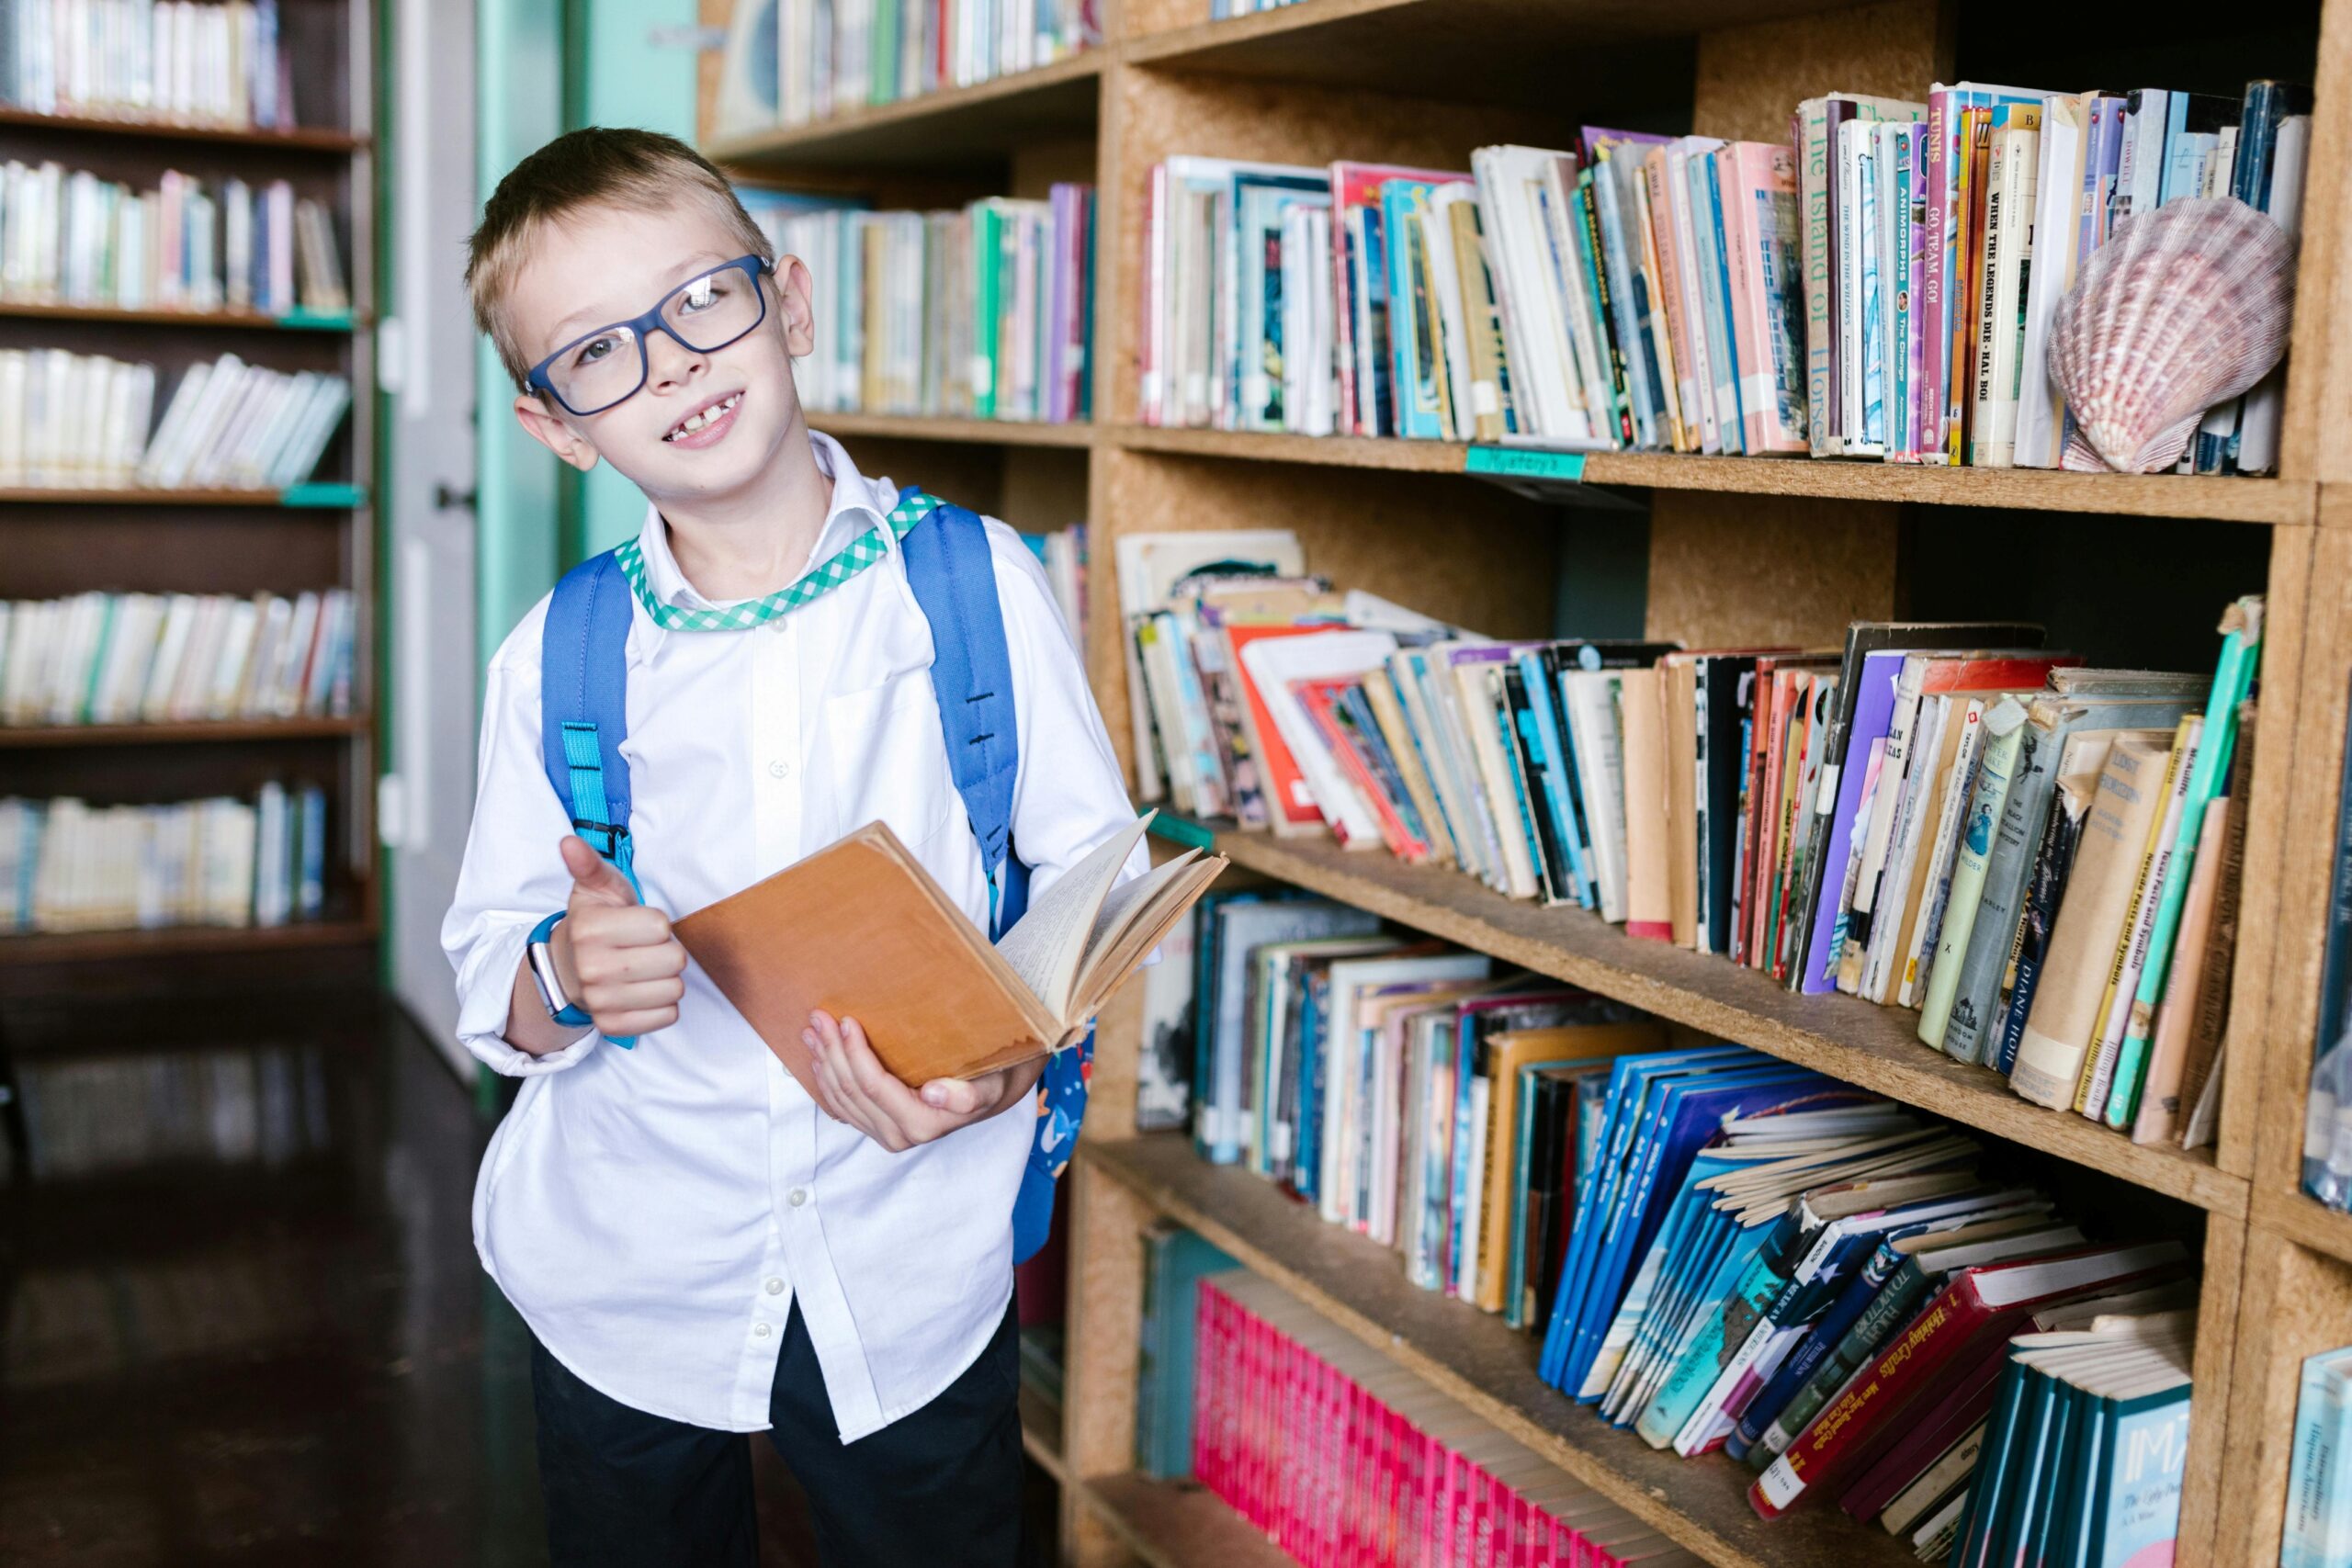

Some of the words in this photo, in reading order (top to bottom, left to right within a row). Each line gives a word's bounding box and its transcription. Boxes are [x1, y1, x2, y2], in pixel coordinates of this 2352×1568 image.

[1807, 117, 1828, 177] The
[1929, 107, 1942, 164] TUNIS
[2122, 141, 2133, 184] DOWELL
[1988, 192, 2000, 231] WHEN
[1810, 190, 1829, 282] Island
[1897, 186, 1908, 281] ANIMORPHS
[1988, 233, 1998, 259] THE
[1844, 251, 1850, 261] IN
[1926, 280, 1939, 303] GO!
[1984, 263, 1997, 317] LEGENDS
[1812, 293, 1829, 323] of
[1898, 317, 1907, 339] The
[1983, 321, 1992, 343] DIE
[1897, 341, 1907, 382] Change
[1980, 352, 1990, 377] HAL
[1811, 348, 1829, 449] Horses
[1961, 732, 1972, 760] TAYLOR
[2113, 750, 2142, 774] LOST
[2168, 748, 2183, 784] Gibson
[2177, 748, 2199, 796] McAuliffe
[2007, 808, 2023, 822] BLACK
[2012, 798, 2022, 808] THE
[1998, 831, 2020, 847] MYSTERY
[2000, 818, 2025, 838] STALLION
[1960, 854, 1983, 873] WILDER
[2045, 847, 2054, 861] the
[2154, 850, 2171, 877] Texas
[2137, 852, 2154, 891] Nevada
[1982, 895, 2007, 915] FARLEY
[2130, 891, 2144, 919] Facts
[2149, 878, 2164, 906] Facts
[2124, 920, 2138, 941] and
[2143, 906, 2155, 926] and
[2009, 916, 2028, 962] Warthog
[2129, 927, 2149, 969] Symbols
[2110, 942, 2131, 987] Symbols
[2015, 964, 2032, 1020] DIANE
[1946, 1032, 1967, 1051] HOUSE
[1948, 1021, 1973, 1041] RANDOM
[2006, 1024, 2021, 1063] HOH
[2086, 1038, 2103, 1070] Hilltop
[2098, 1041, 2118, 1077] Hilltop
[2079, 1073, 2094, 1105] Books
[2092, 1080, 2108, 1109] Books
[1893, 1270, 1911, 1291] TO
[1770, 1282, 1800, 1322] MEXICAN
[1853, 1286, 1895, 1338] VICTORY
[1862, 1306, 1900, 1345] FLIGHT
[1907, 1305, 1948, 1349] Holiday
[1879, 1341, 1912, 1379] Crafts
[1862, 1381, 1880, 1401] More
[1812, 1428, 1836, 1452] Crafts
